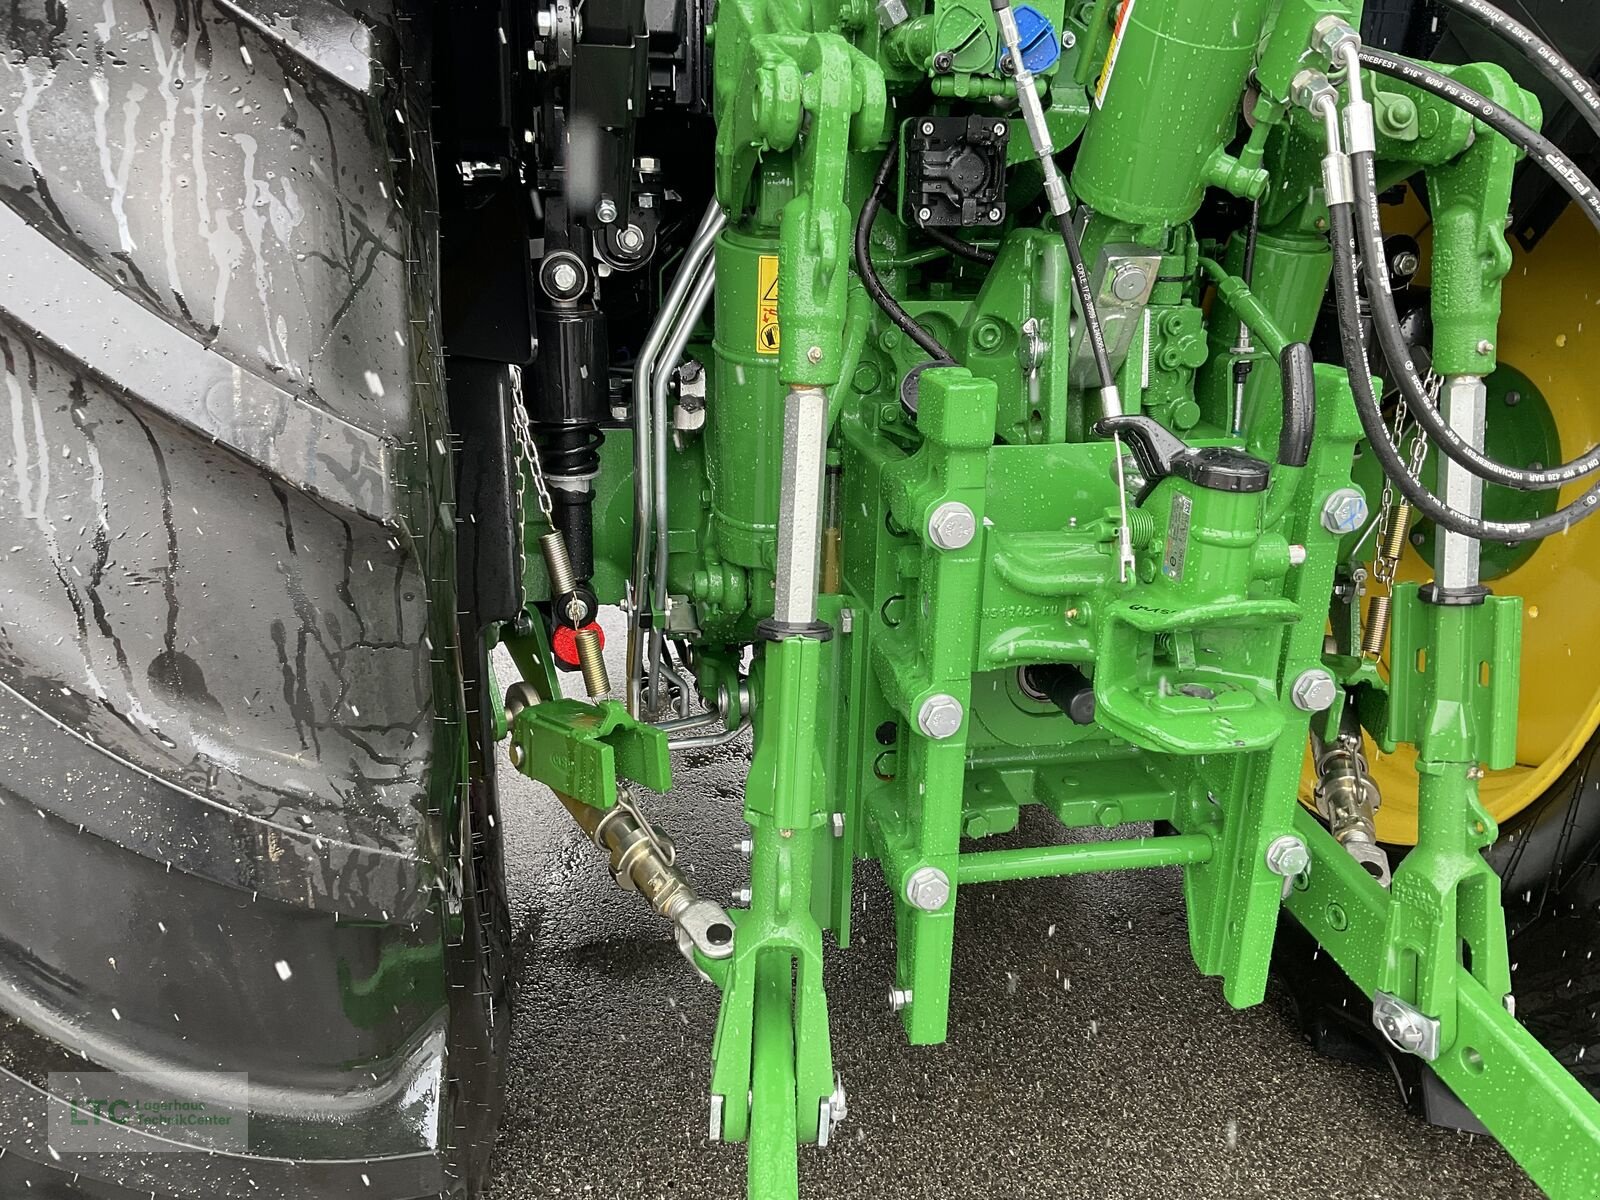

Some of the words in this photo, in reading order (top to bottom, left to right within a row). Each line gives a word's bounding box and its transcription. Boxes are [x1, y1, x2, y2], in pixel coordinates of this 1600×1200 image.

[1537, 46, 1551, 59] DN
[1560, 66, 1574, 78] WP
[1572, 79, 1586, 93] 420
[1583, 92, 1600, 109] BAR
[1425, 76, 1444, 89] 6090
[1444, 85, 1460, 96] PSI
[1460, 92, 1480, 107] 2Q25
[1545, 153, 1591, 195] dietzel
[1587, 458, 1600, 469] DN
[1529, 472, 1545, 482] BAR
[1547, 473, 1561, 481] 420
[1563, 470, 1576, 479] WP
